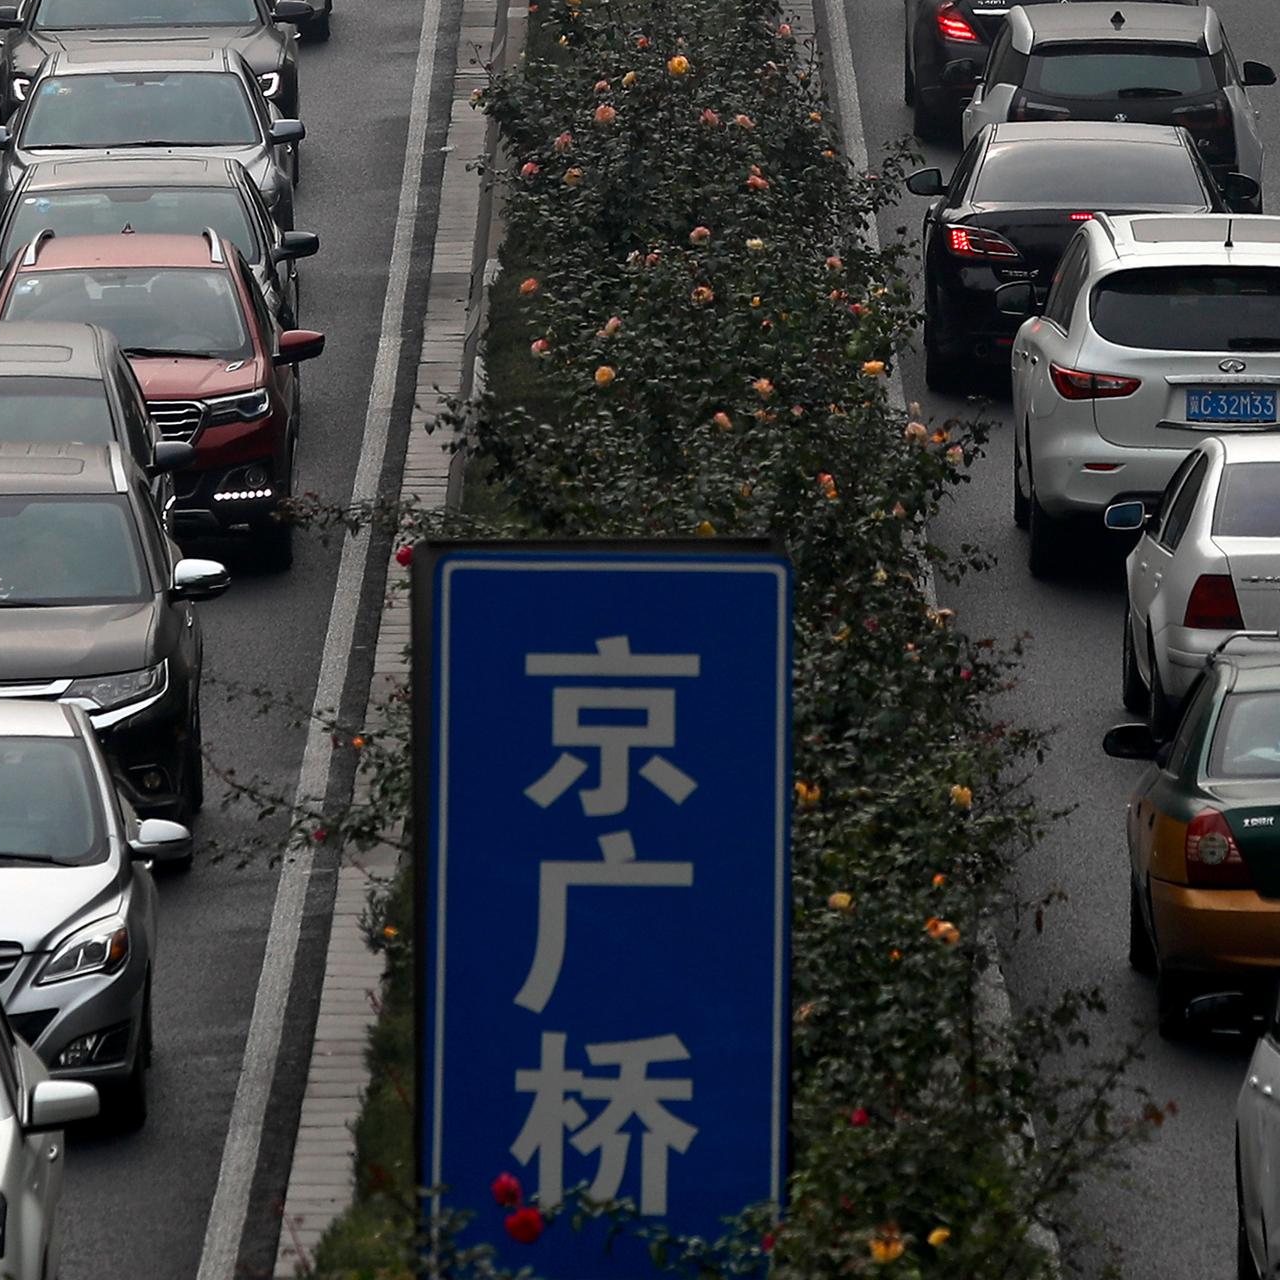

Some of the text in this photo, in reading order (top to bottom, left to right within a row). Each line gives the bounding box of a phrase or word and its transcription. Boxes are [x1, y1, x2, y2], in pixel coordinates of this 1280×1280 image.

[1190, 394, 1274, 418] 冀C·32M33
[510, 634, 701, 1217] 京广桥
